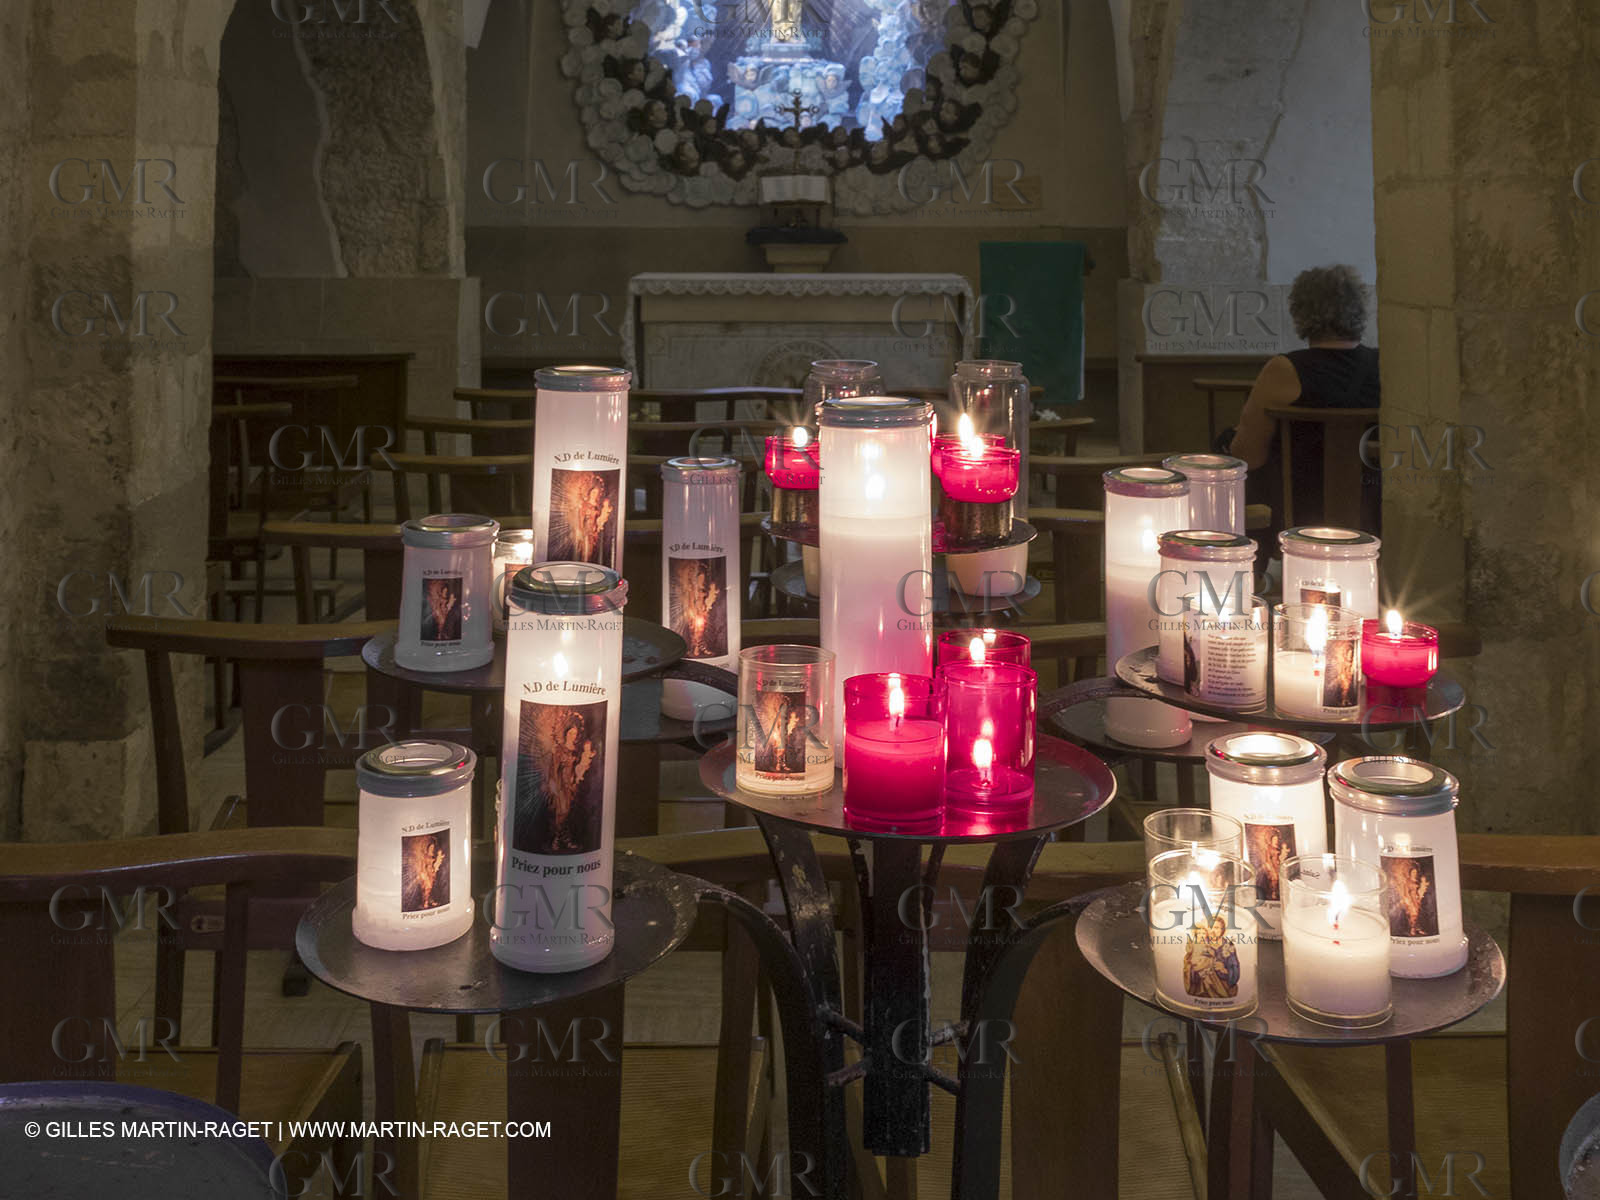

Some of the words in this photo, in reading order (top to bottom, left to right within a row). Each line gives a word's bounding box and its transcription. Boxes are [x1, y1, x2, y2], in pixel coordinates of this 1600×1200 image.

[573, 451, 585, 460] de
[587, 450, 620, 465] Lumière
[523, 681, 542, 695] N.D
[545, 681, 559, 691] de
[563, 680, 606, 696] Lumière
[512, 856, 540, 874] Priez
[543, 865, 573, 878] pour
[576, 860, 601, 874] nous
